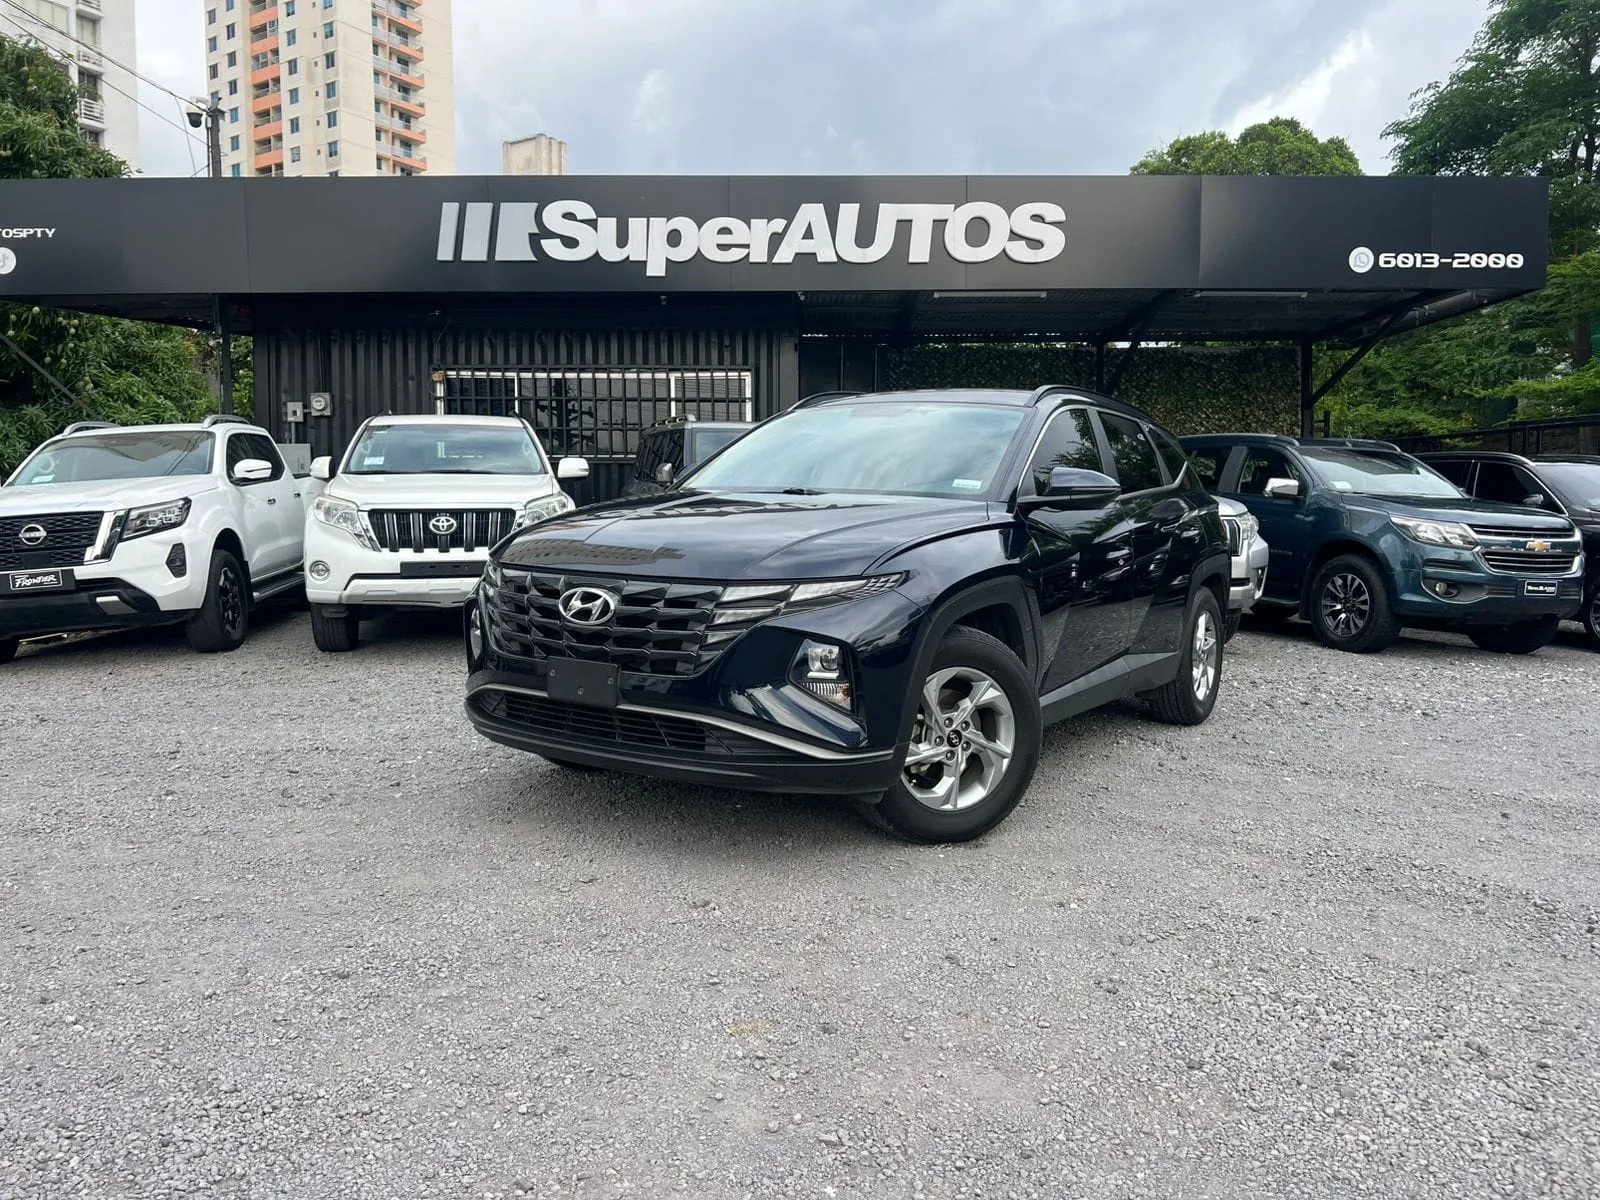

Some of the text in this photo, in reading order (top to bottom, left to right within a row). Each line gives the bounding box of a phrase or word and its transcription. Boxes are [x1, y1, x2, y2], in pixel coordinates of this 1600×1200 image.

[0, 228, 57, 238] OSPTY
[540, 200, 1066, 277] SuperAUTOS
[1378, 252, 1524, 268] 6013-2000
